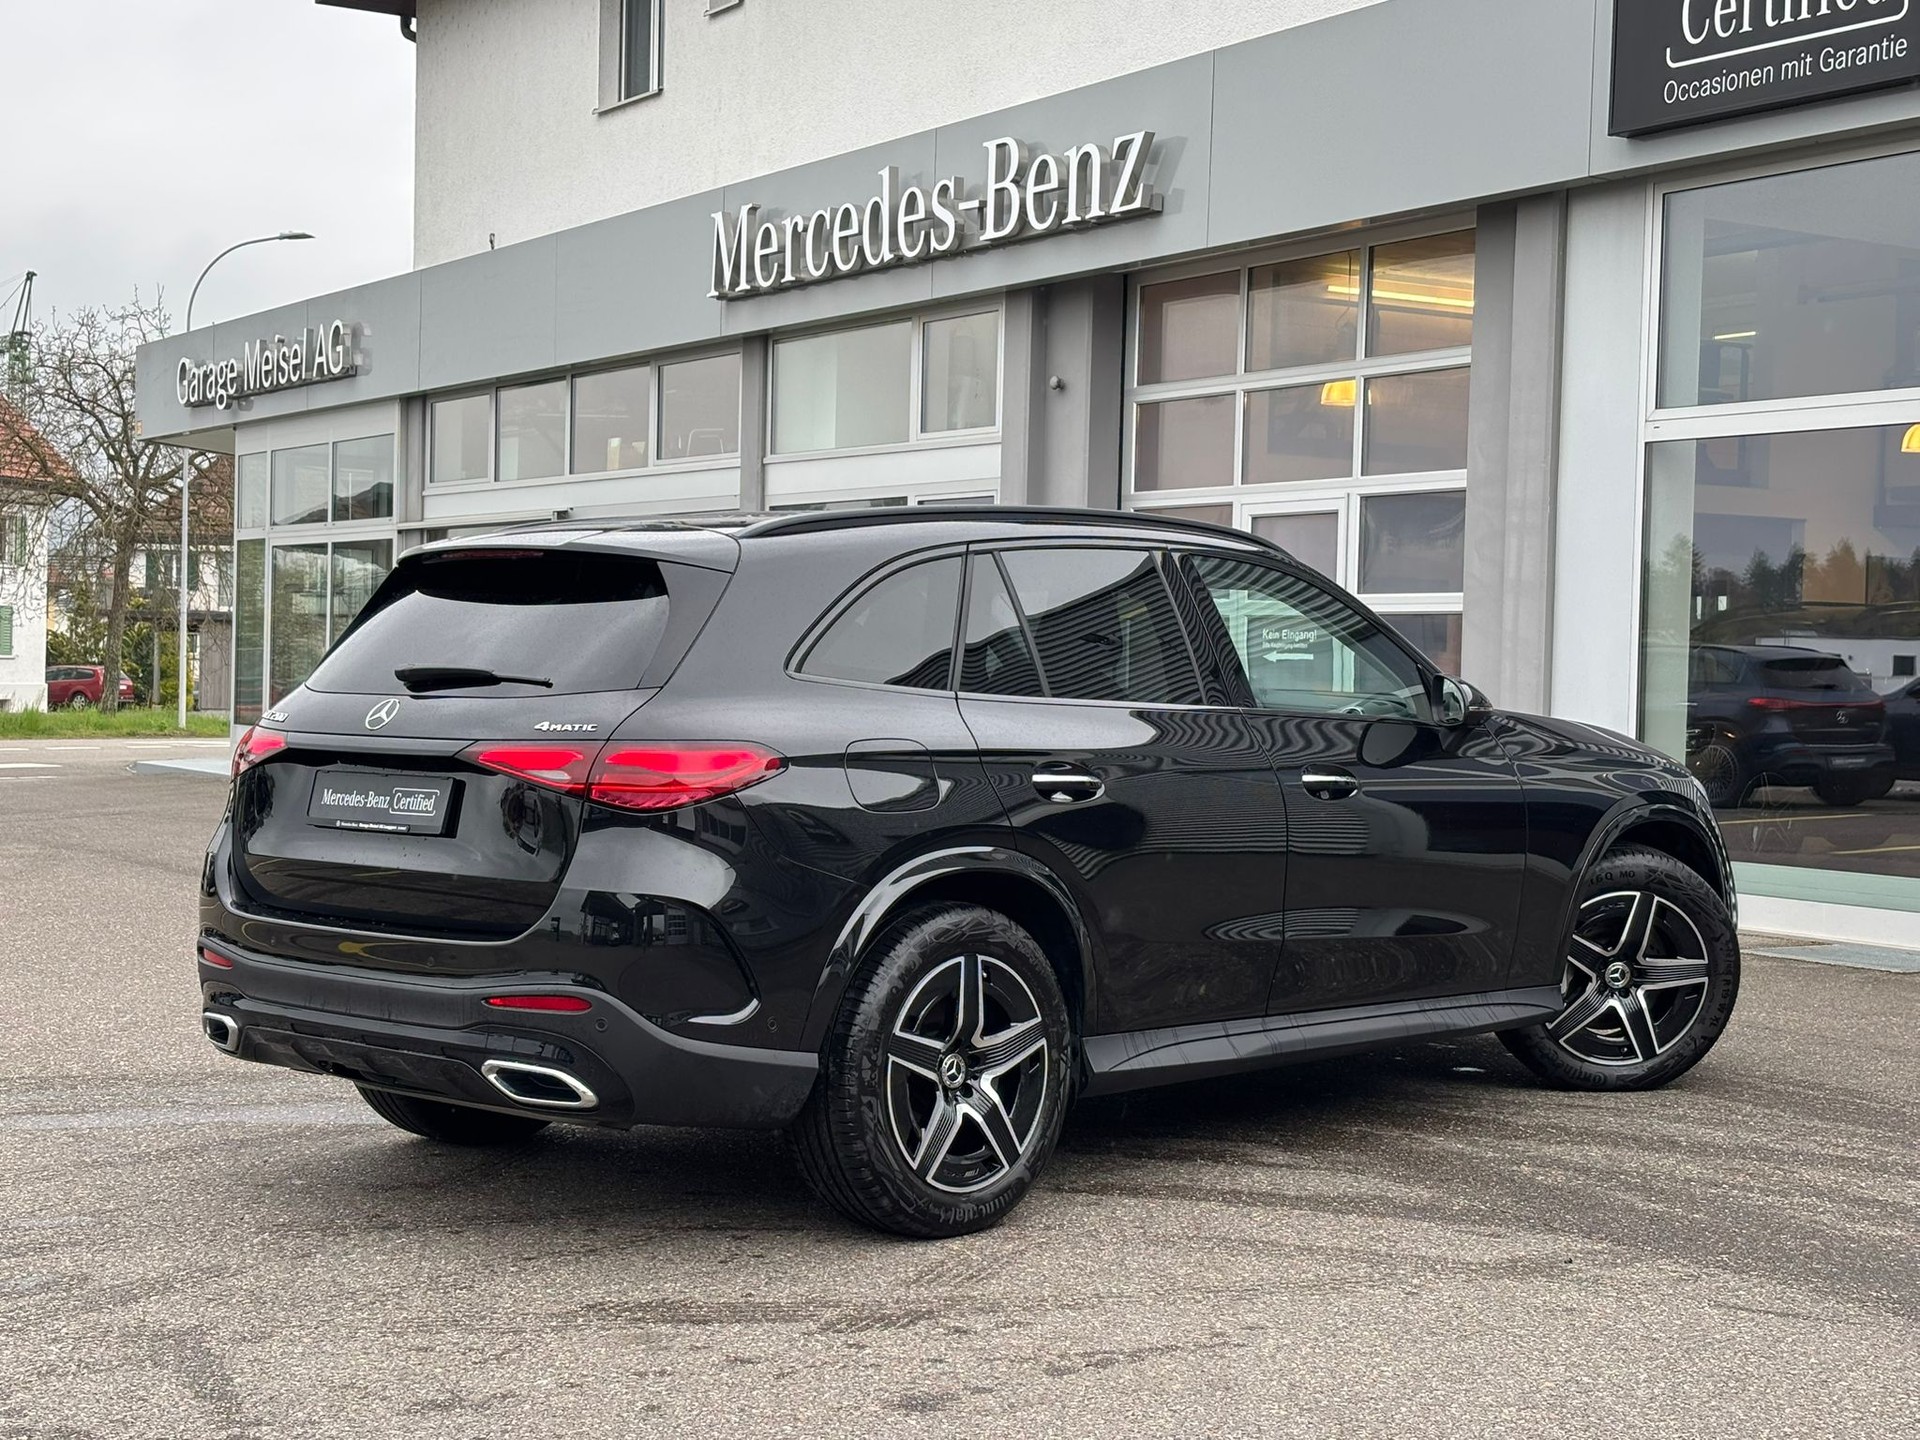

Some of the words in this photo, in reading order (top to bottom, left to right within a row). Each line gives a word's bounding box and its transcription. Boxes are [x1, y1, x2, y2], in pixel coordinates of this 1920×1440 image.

[1663, 69, 1774, 104] Occasionen
[1780, 53, 1813, 82] mit
[1819, 34, 1908, 73] Garantie
[706, 130, 1152, 298] Mercedes-Benz
[176, 356, 238, 410] Garage
[243, 328, 309, 391] Meisel
[312, 319, 345, 378] AG
[534, 721, 598, 732] 4MATIC
[321, 788, 390, 809] Mercedes-Benz
[393, 792, 436, 812] Certified
